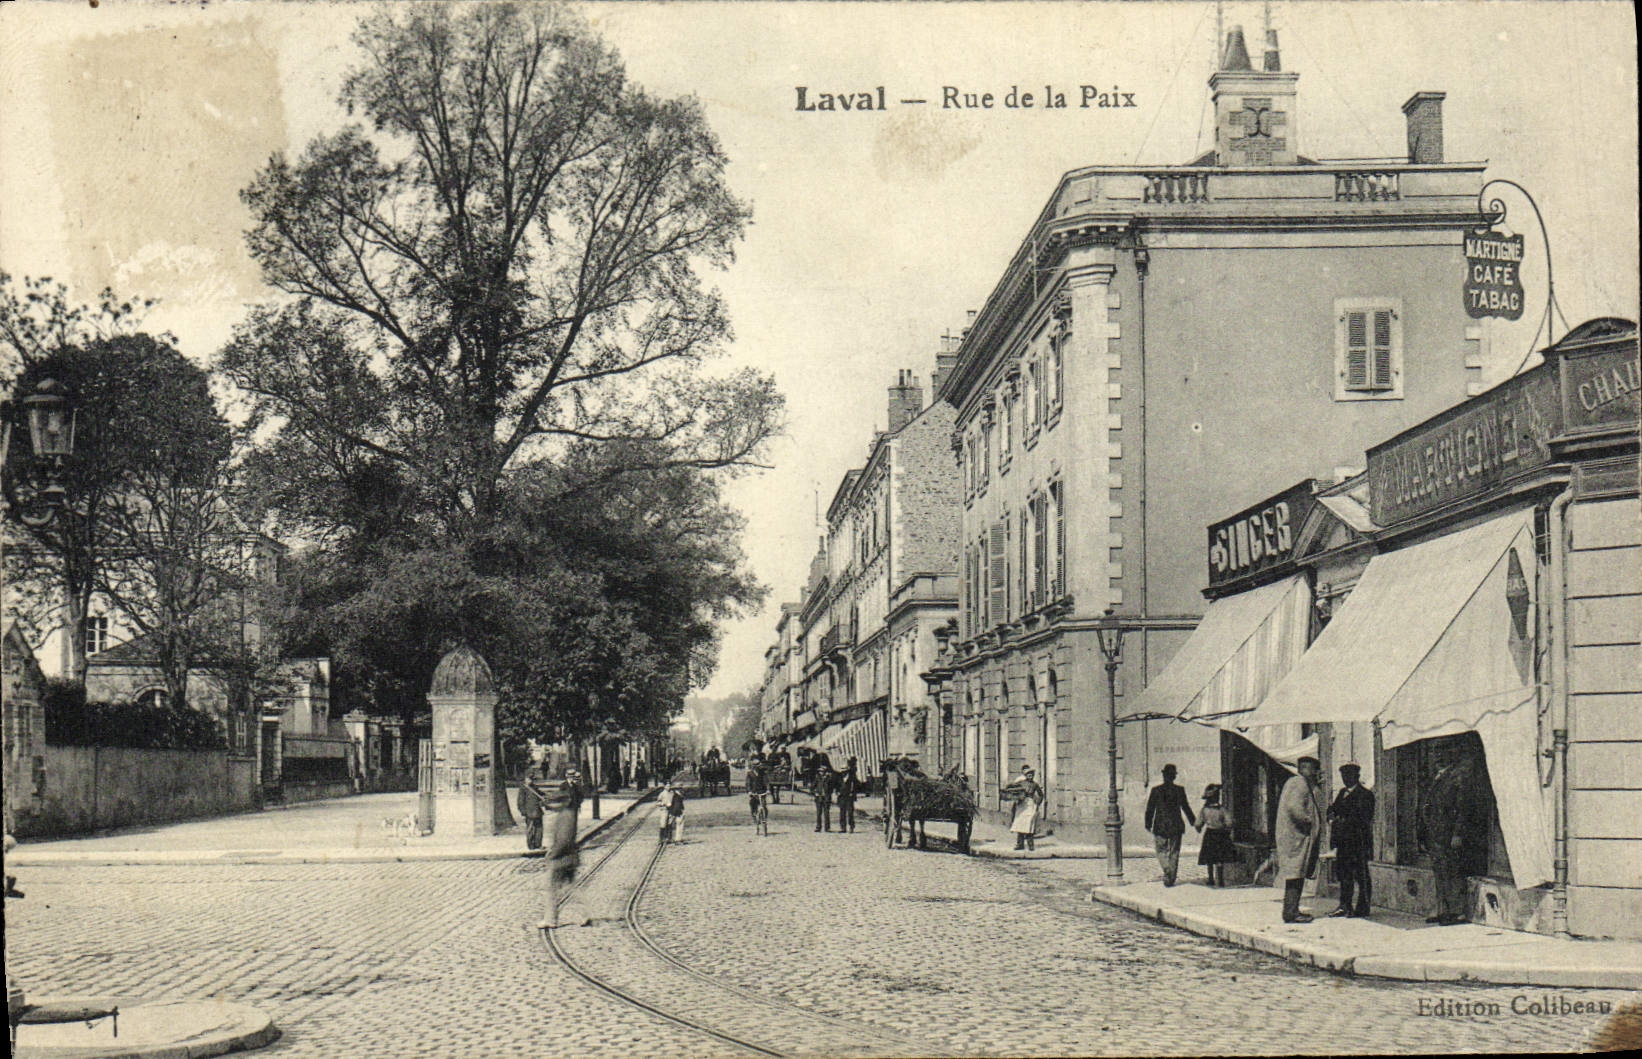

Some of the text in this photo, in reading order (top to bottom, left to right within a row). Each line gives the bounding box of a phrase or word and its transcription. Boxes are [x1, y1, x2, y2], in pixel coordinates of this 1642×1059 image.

[1466, 239, 1521, 261] MARTIGNÉ
[1474, 263, 1513, 286] CAFÉ
[1469, 288, 1519, 311] TABAC
[1210, 501, 1292, 573] SINGER
